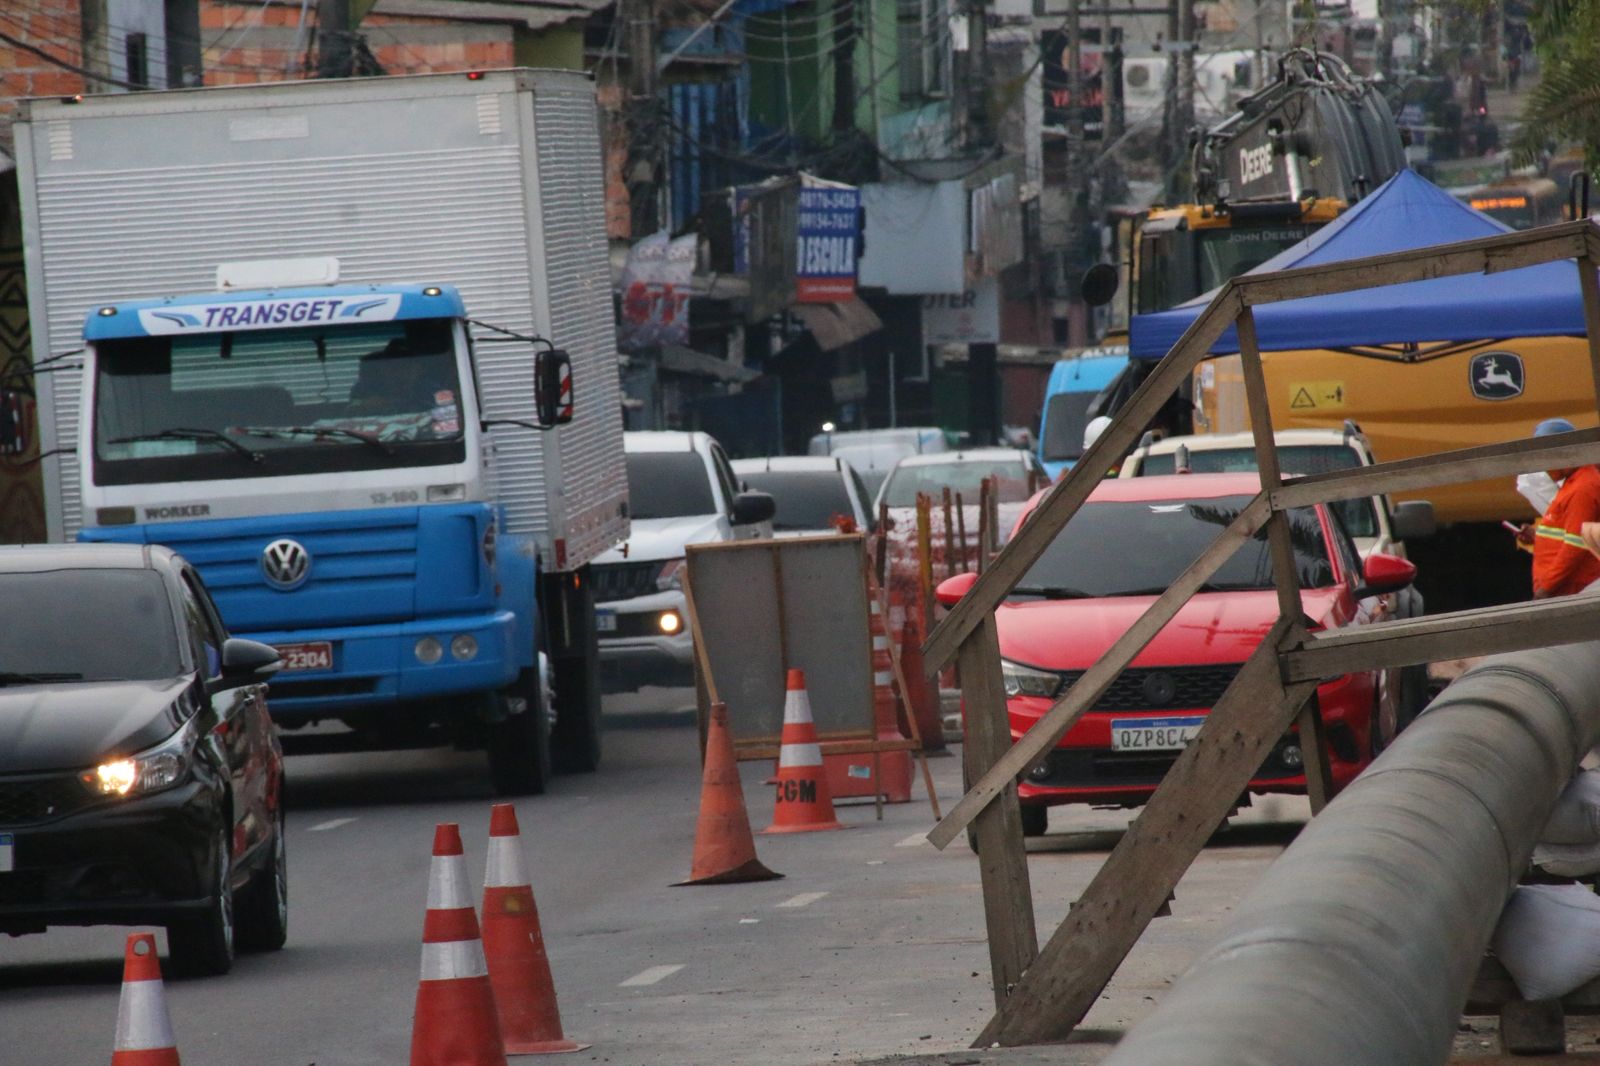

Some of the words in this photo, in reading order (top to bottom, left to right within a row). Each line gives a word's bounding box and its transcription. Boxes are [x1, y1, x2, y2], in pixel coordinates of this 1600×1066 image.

[1240, 143, 1273, 184] DEERE
[1228, 232, 1260, 243] JOHN
[1262, 230, 1303, 240] DEERE
[806, 236, 856, 273] ESCOLA
[205, 300, 343, 327] TRANSGET
[145, 504, 210, 519] WORKER
